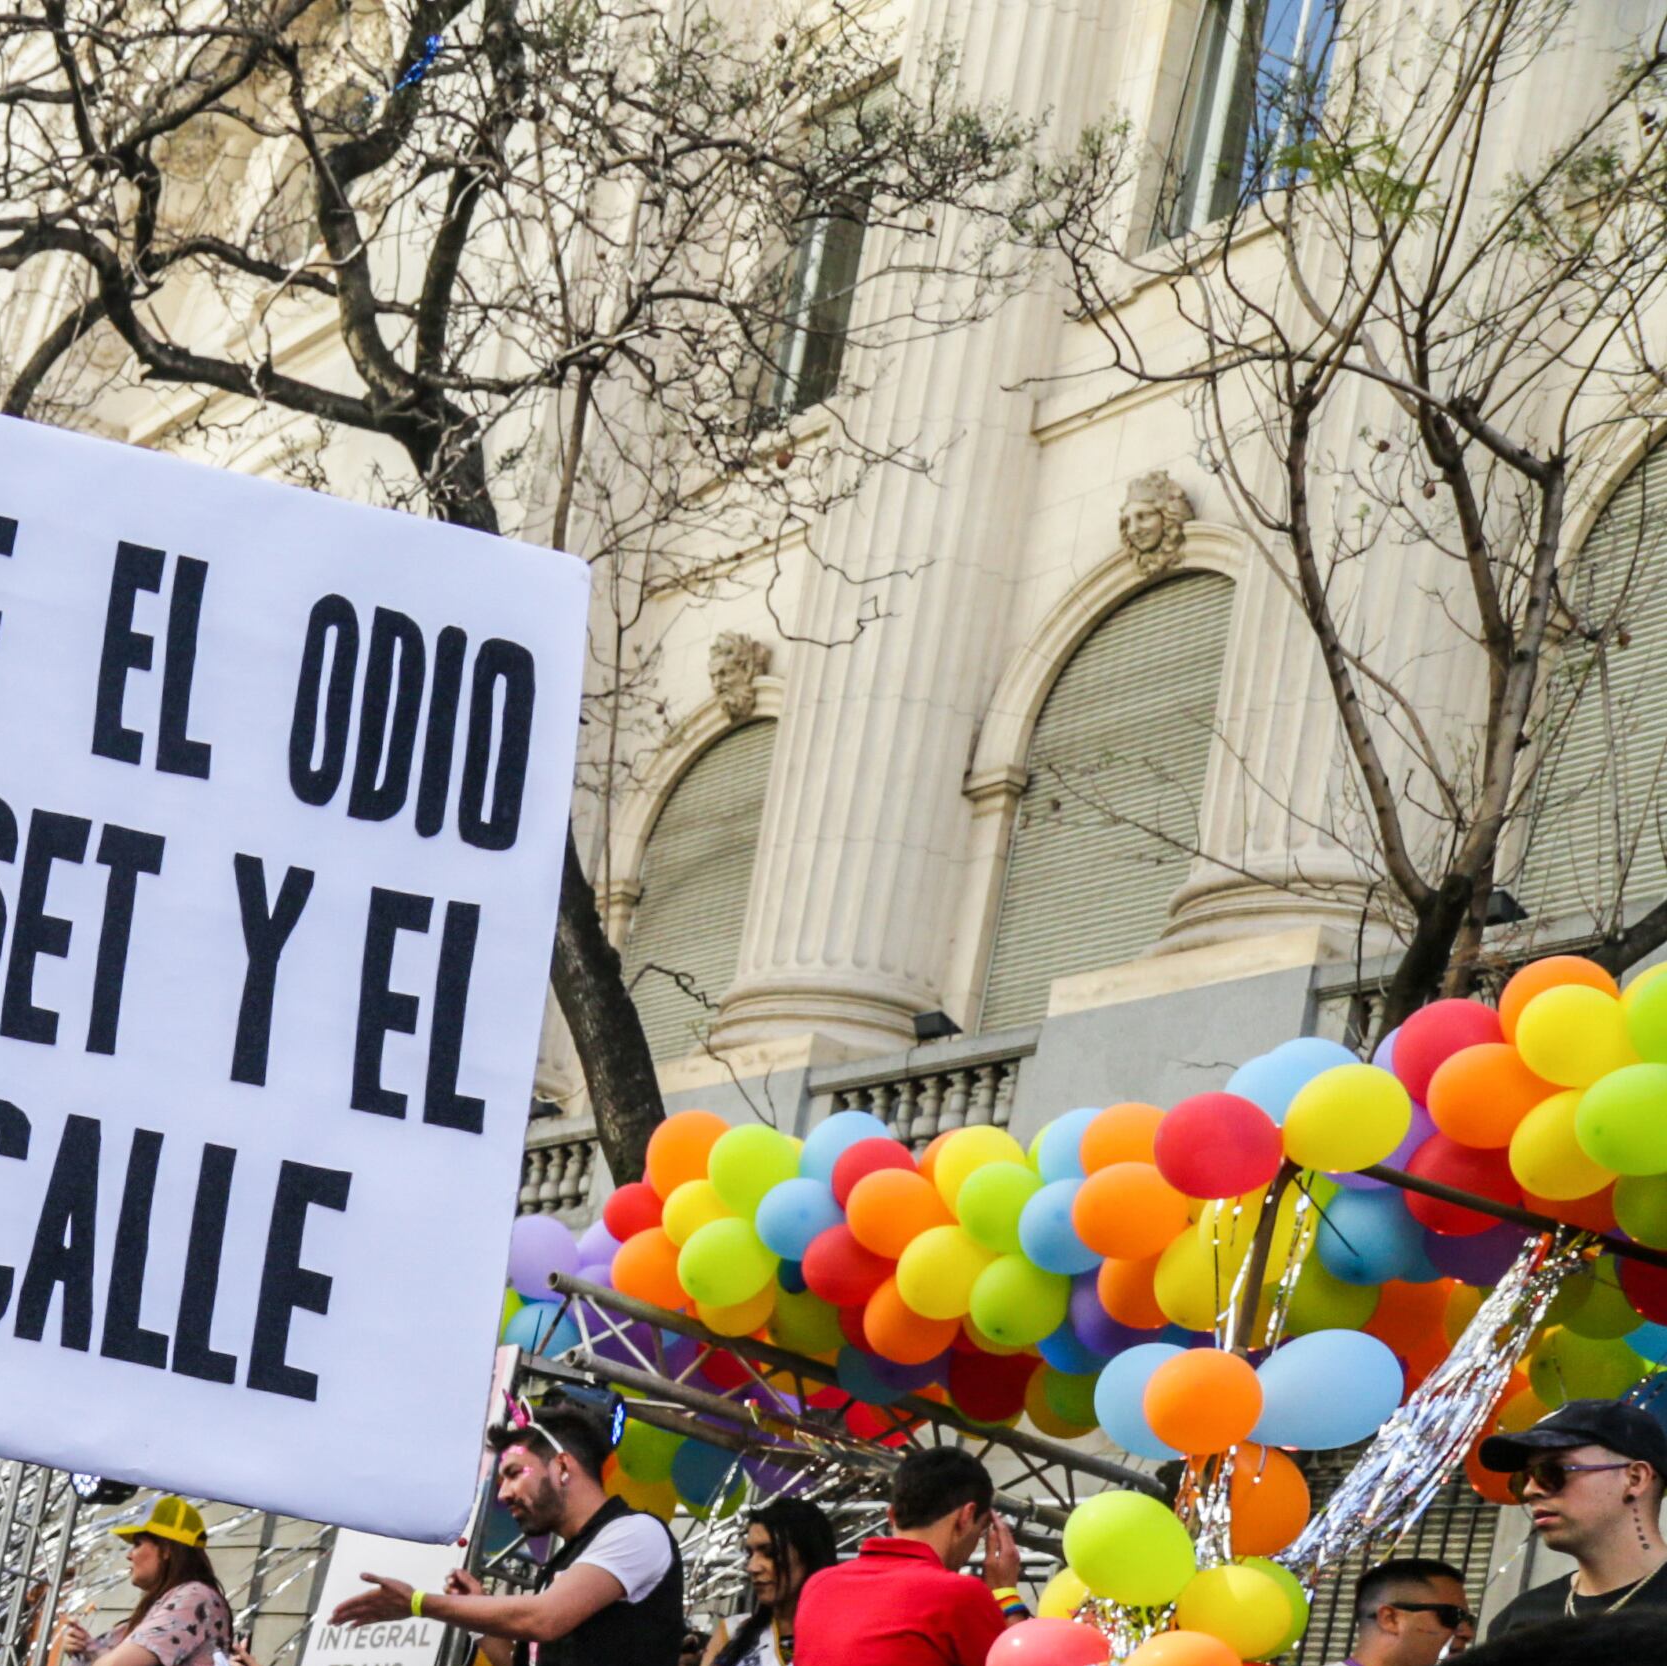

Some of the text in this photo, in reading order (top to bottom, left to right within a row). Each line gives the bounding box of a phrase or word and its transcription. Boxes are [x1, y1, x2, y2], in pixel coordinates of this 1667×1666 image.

[92, 541, 211, 779] EL
[289, 594, 535, 850] ODIO
[231, 853, 314, 1087] Y
[351, 887, 485, 1134] EL
[317, 1624, 431, 1650] INTEGRAL
